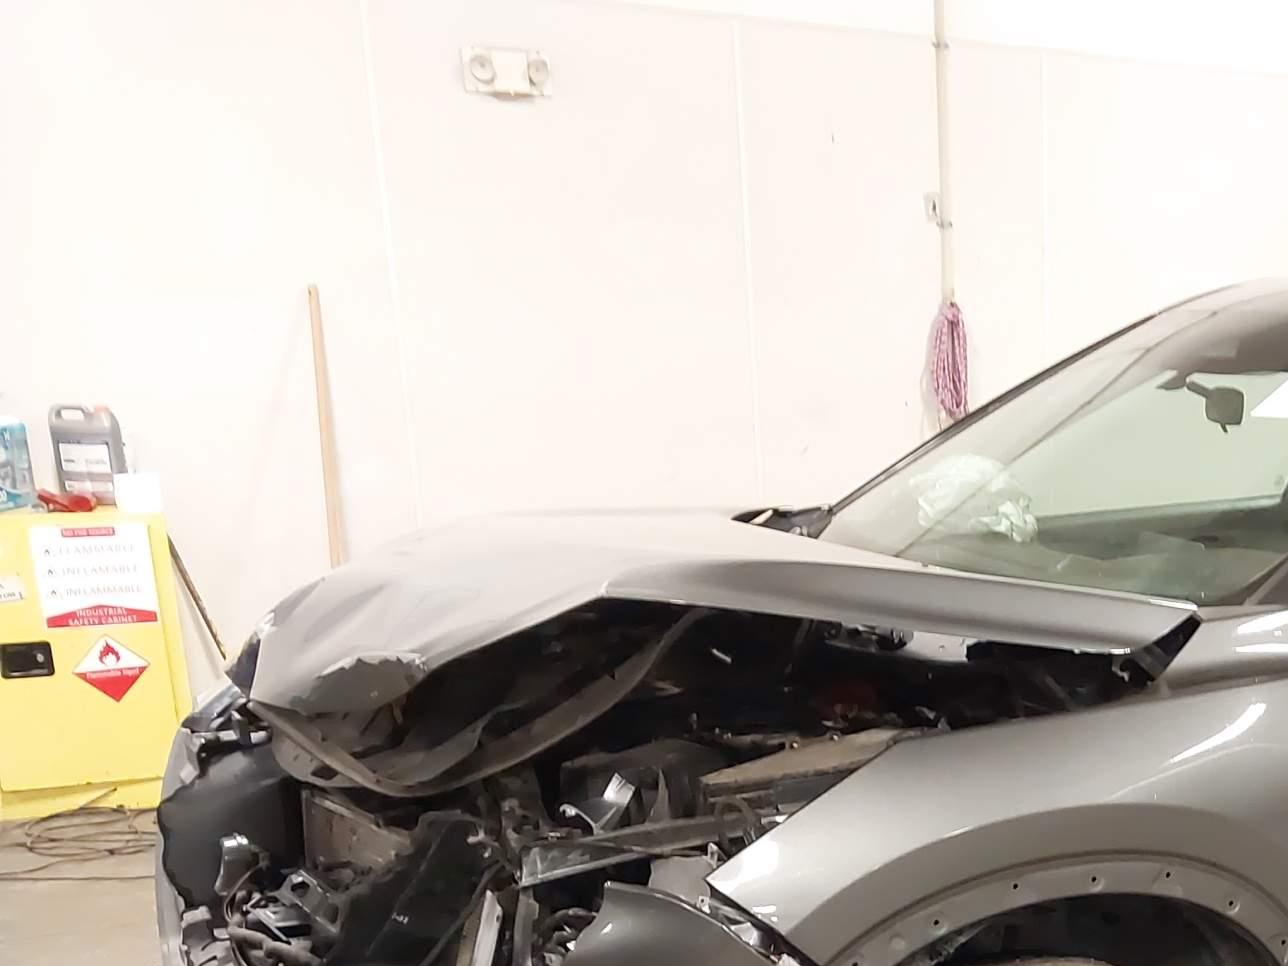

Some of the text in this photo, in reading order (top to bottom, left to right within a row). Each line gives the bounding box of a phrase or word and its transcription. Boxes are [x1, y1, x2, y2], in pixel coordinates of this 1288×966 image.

[76, 607, 127, 617] INDUSTRIAL
[68, 615, 137, 626] SAFETY CABINET
